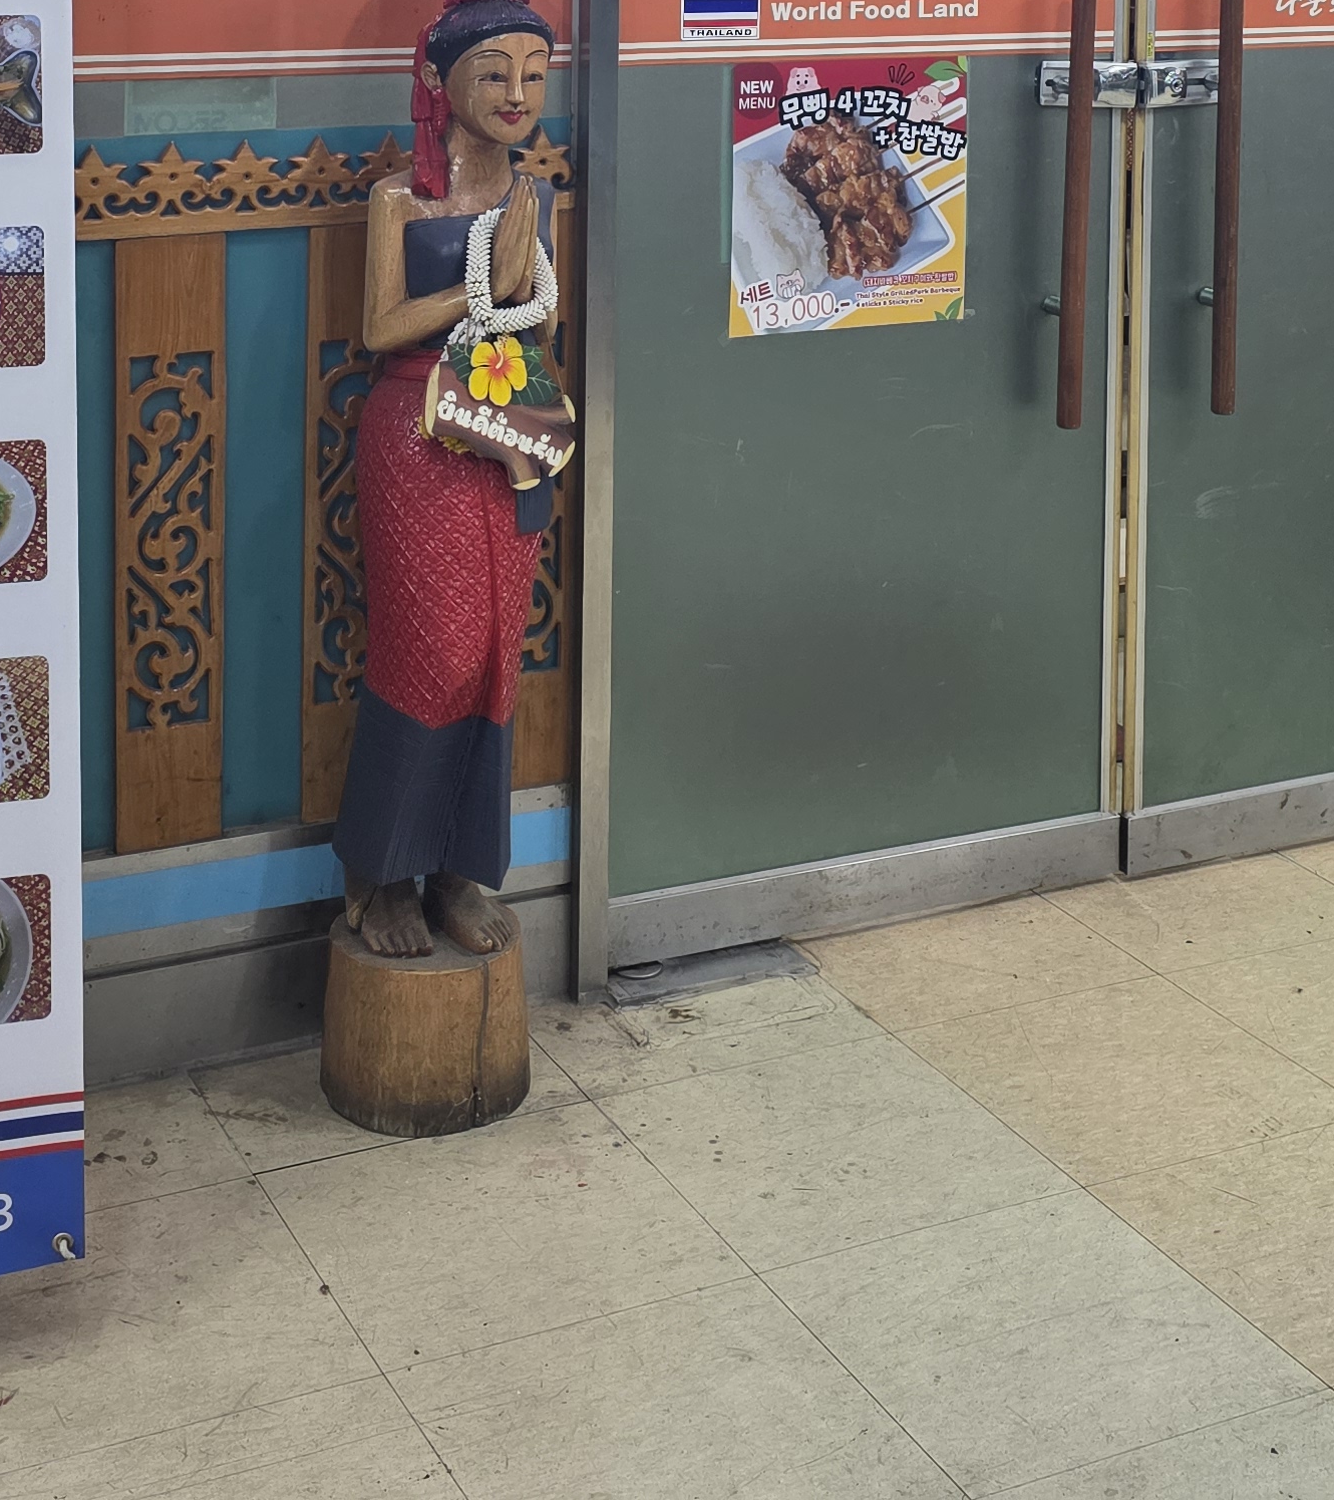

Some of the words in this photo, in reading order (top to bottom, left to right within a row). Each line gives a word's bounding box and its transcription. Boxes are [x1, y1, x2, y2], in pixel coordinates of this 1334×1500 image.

[771, 1, 841, 21] World
[850, 0, 912, 19] Food
[688, 27, 753, 38] THAILAND
[740, 80, 774, 94] NEW
[739, 97, 775, 110] MENU
[782, 93, 827, 126] 무삥
[863, 90, 908, 117] 꼬치
[740, 282, 774, 304] 세트
